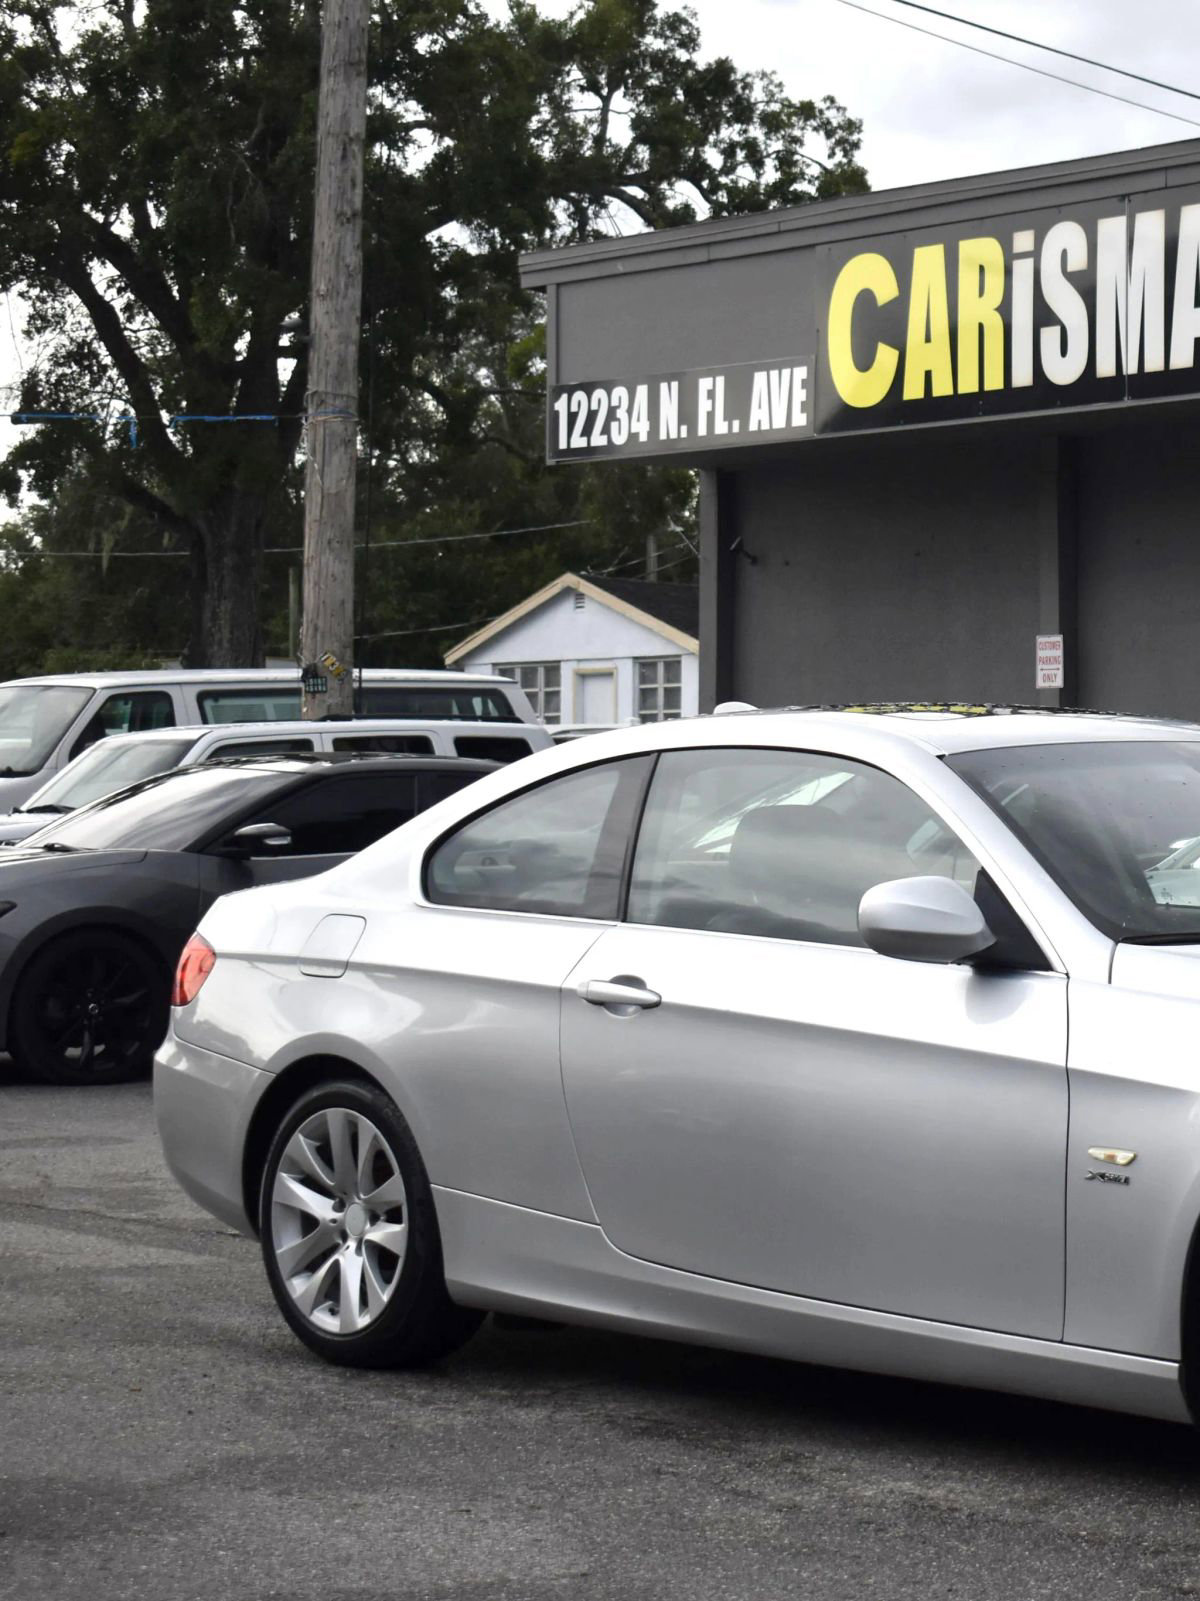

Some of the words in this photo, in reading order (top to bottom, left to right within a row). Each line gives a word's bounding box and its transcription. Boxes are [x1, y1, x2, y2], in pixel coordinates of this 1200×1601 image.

[554, 384, 650, 450] 12234
[659, 380, 688, 441] N.
[697, 375, 740, 437] FL.
[748, 366, 808, 432] AVE
[1039, 655, 1061, 666] PARKING
[1042, 673, 1057, 683] ONLY
